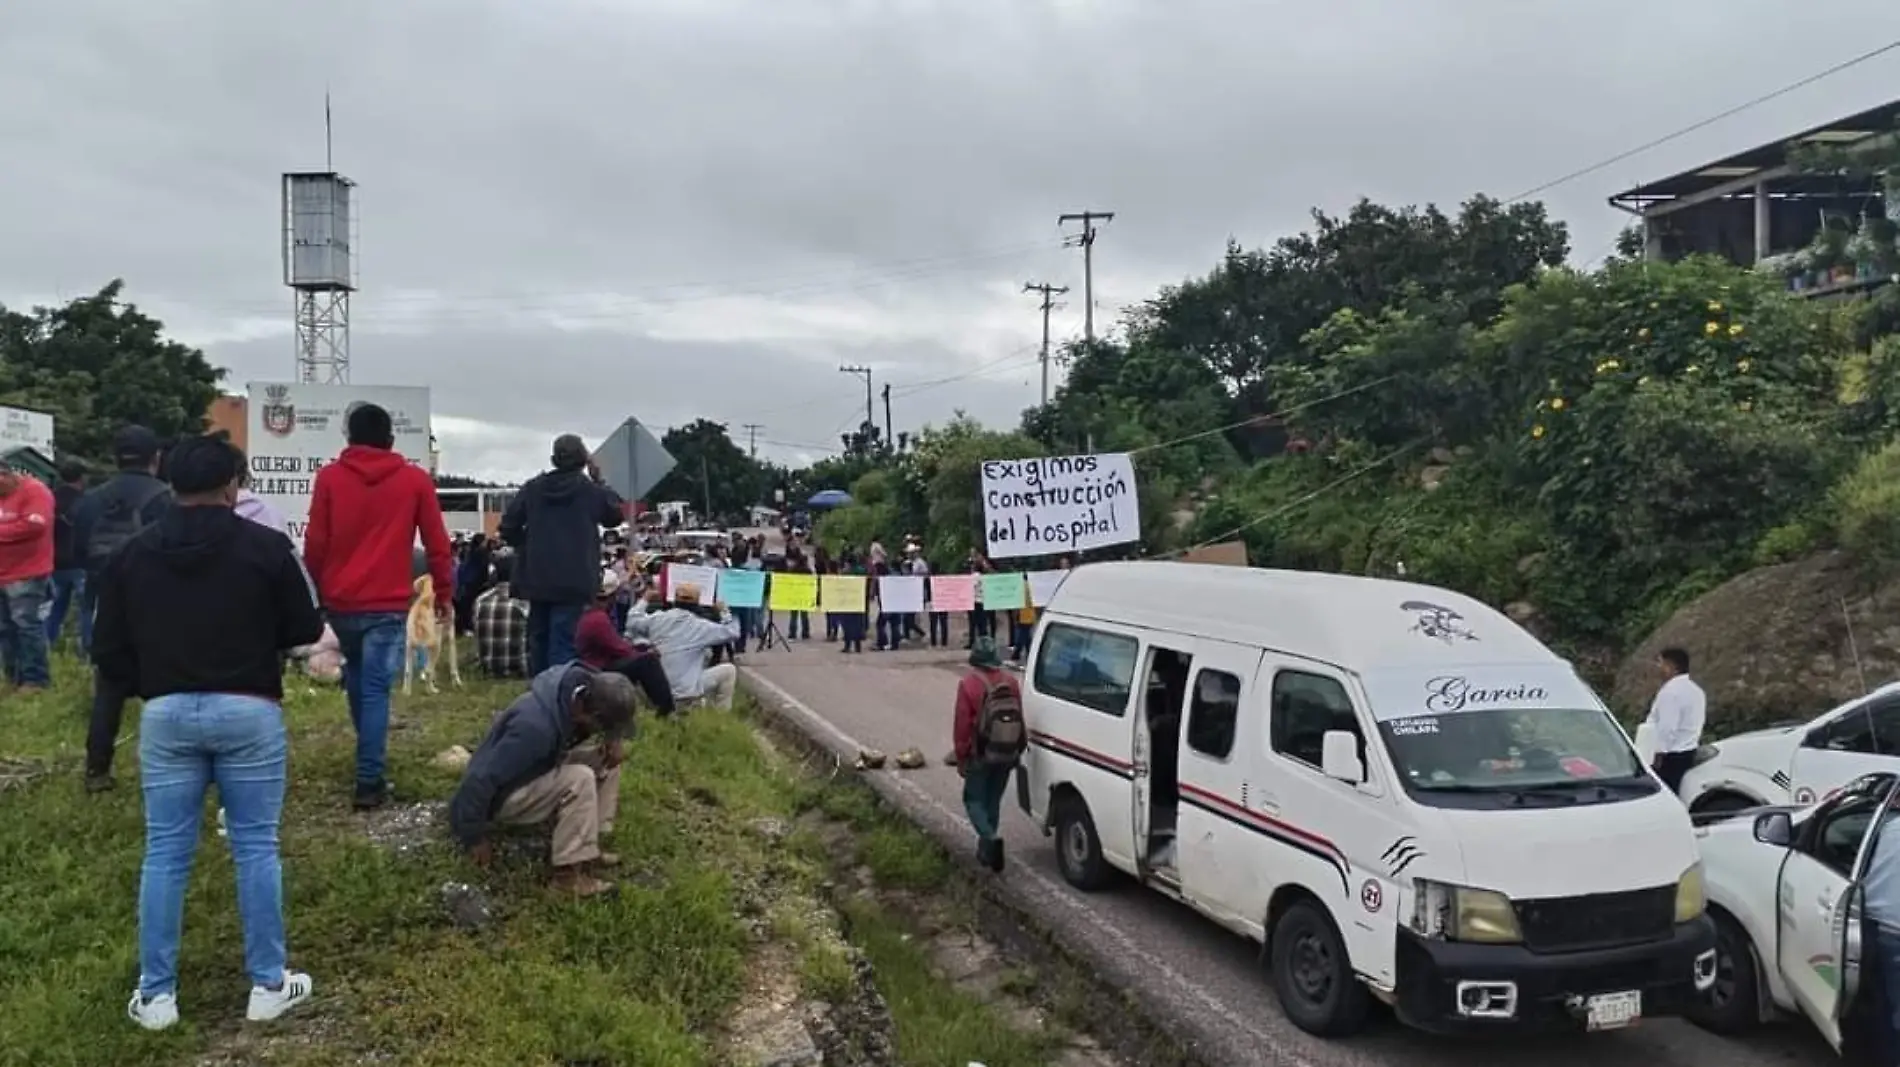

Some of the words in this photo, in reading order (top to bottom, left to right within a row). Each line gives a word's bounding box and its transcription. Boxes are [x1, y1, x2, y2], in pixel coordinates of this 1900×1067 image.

[252, 456, 302, 472] COLEGIO
[989, 514, 1016, 543] del
[1025, 502, 1118, 548] hospital
